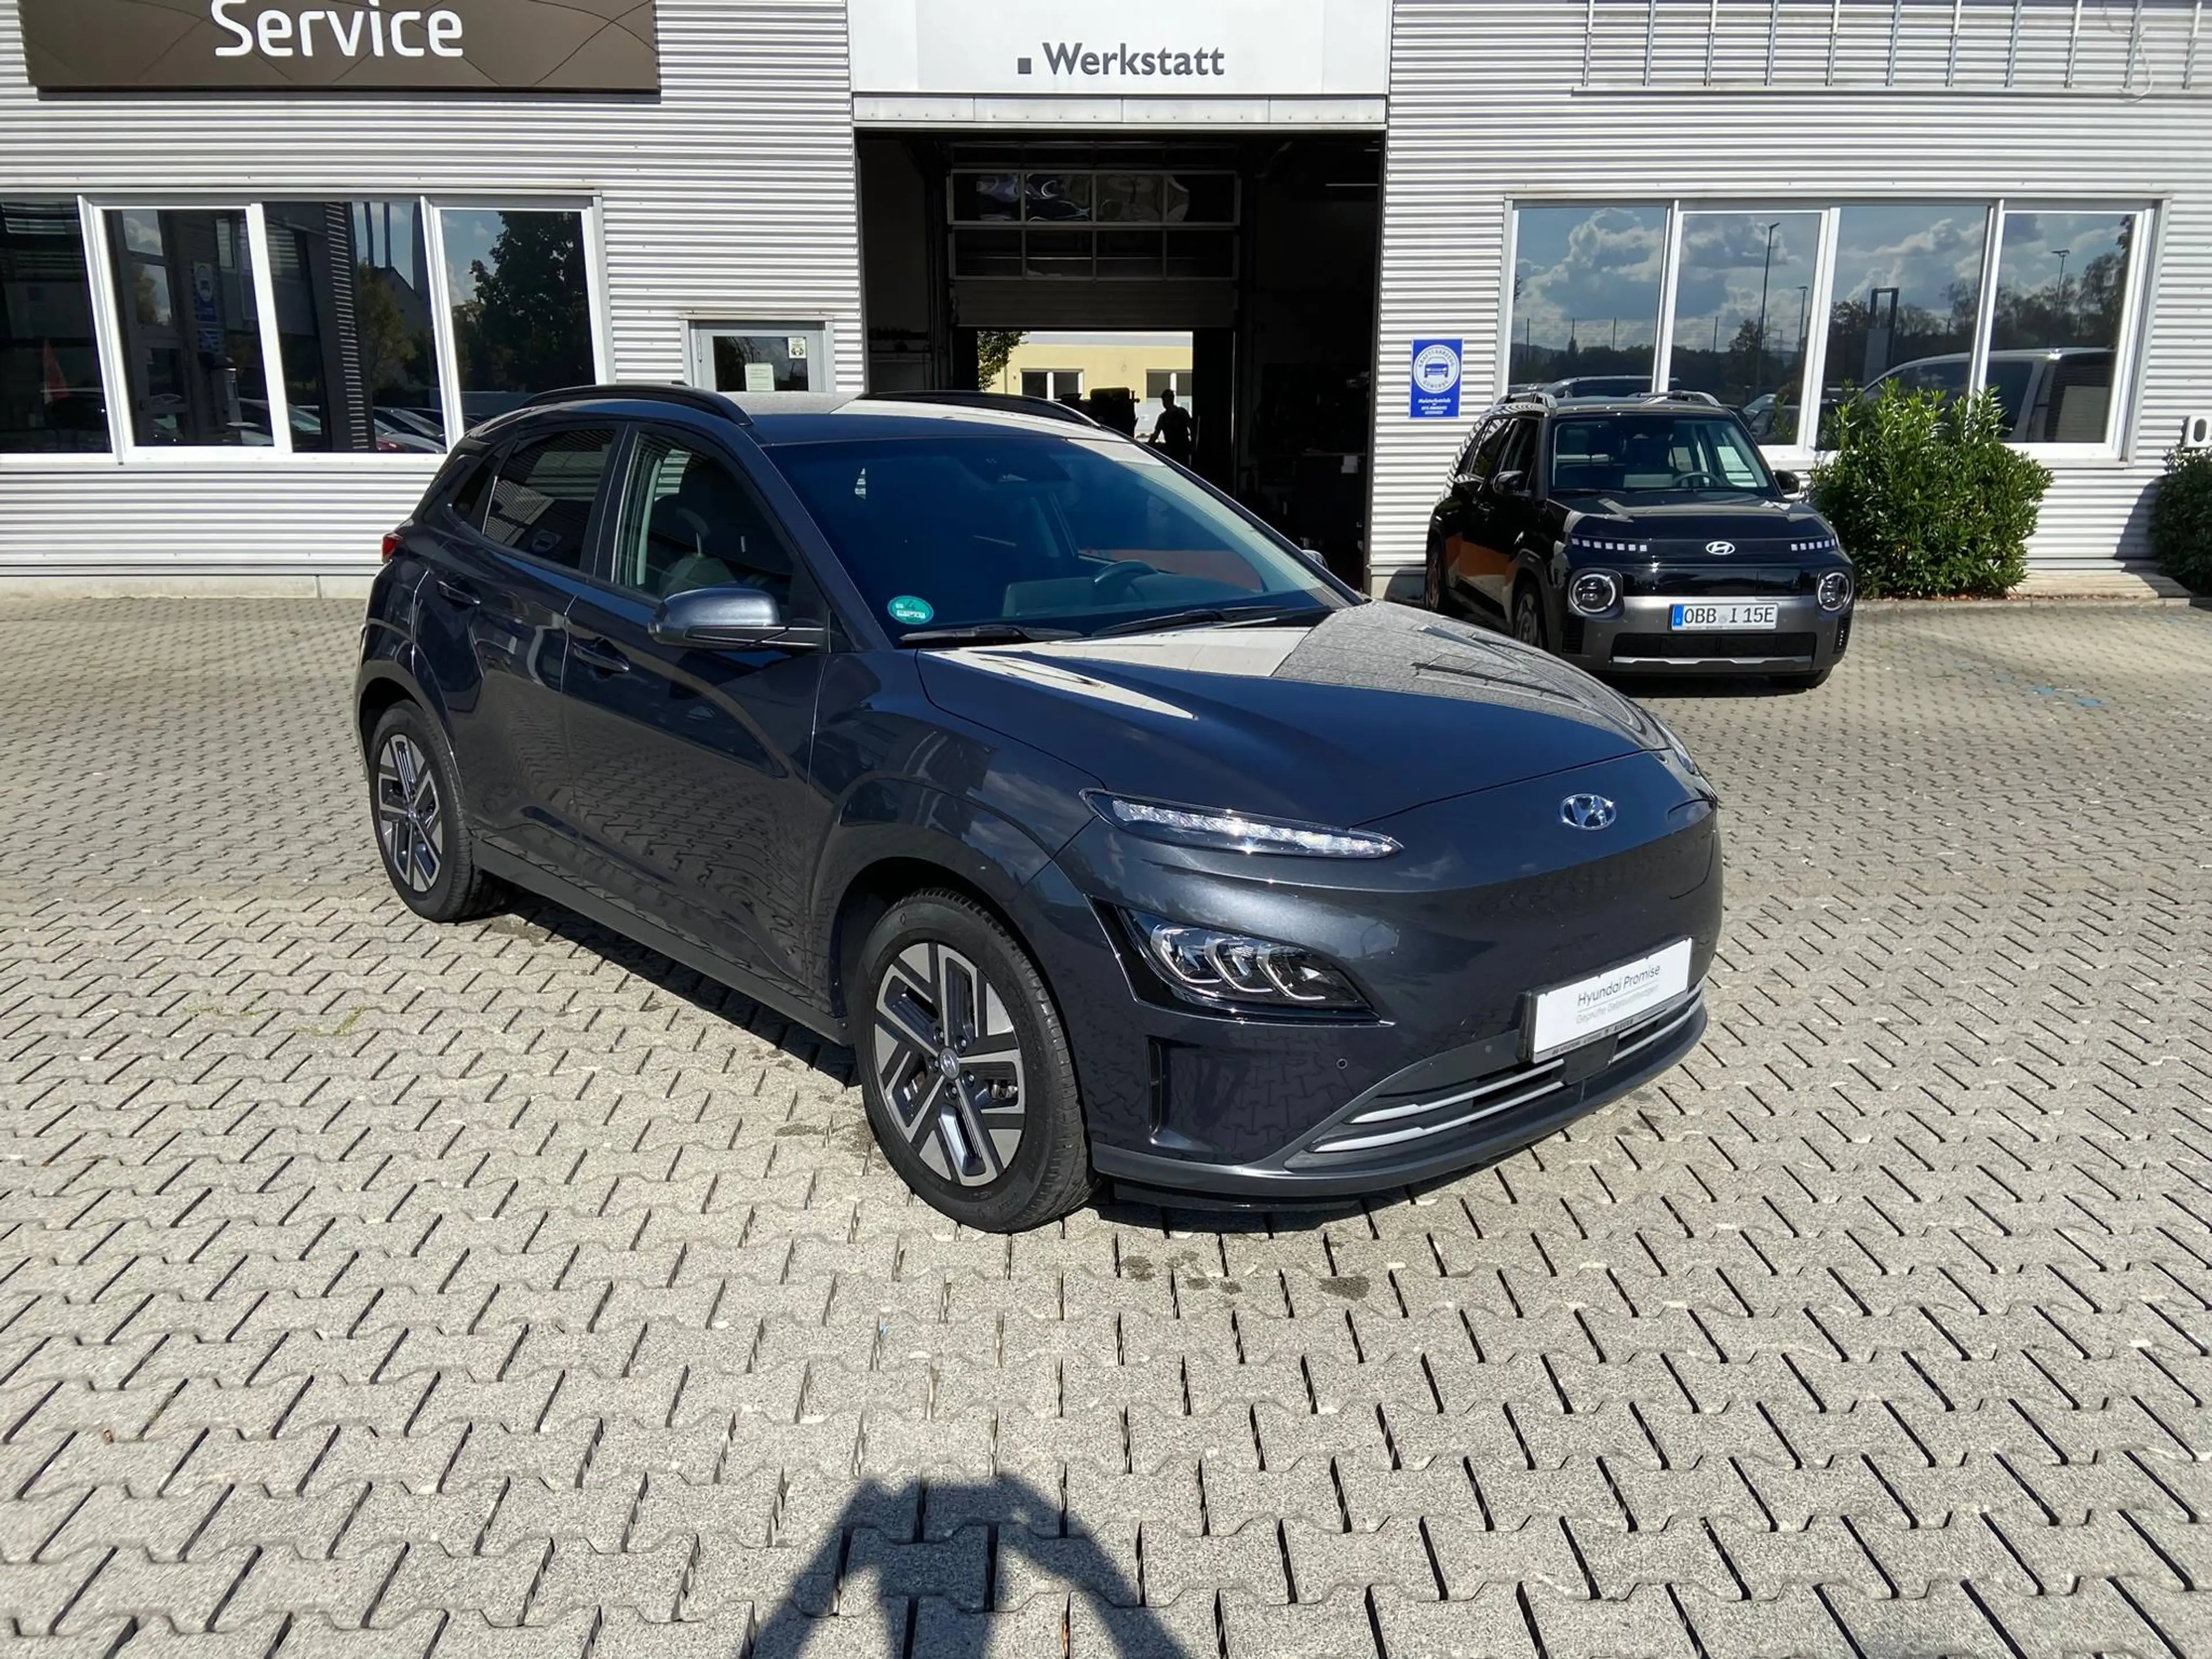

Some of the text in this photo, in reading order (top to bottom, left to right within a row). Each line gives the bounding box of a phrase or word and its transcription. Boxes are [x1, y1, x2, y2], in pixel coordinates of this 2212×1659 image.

[211, 0, 463, 56] Service
[1042, 42, 1225, 75] Werkstatt
[1684, 608, 1717, 624] OBB
[1743, 607, 1775, 623] 15E
[1577, 965, 1660, 1007] Hyundai Promise
